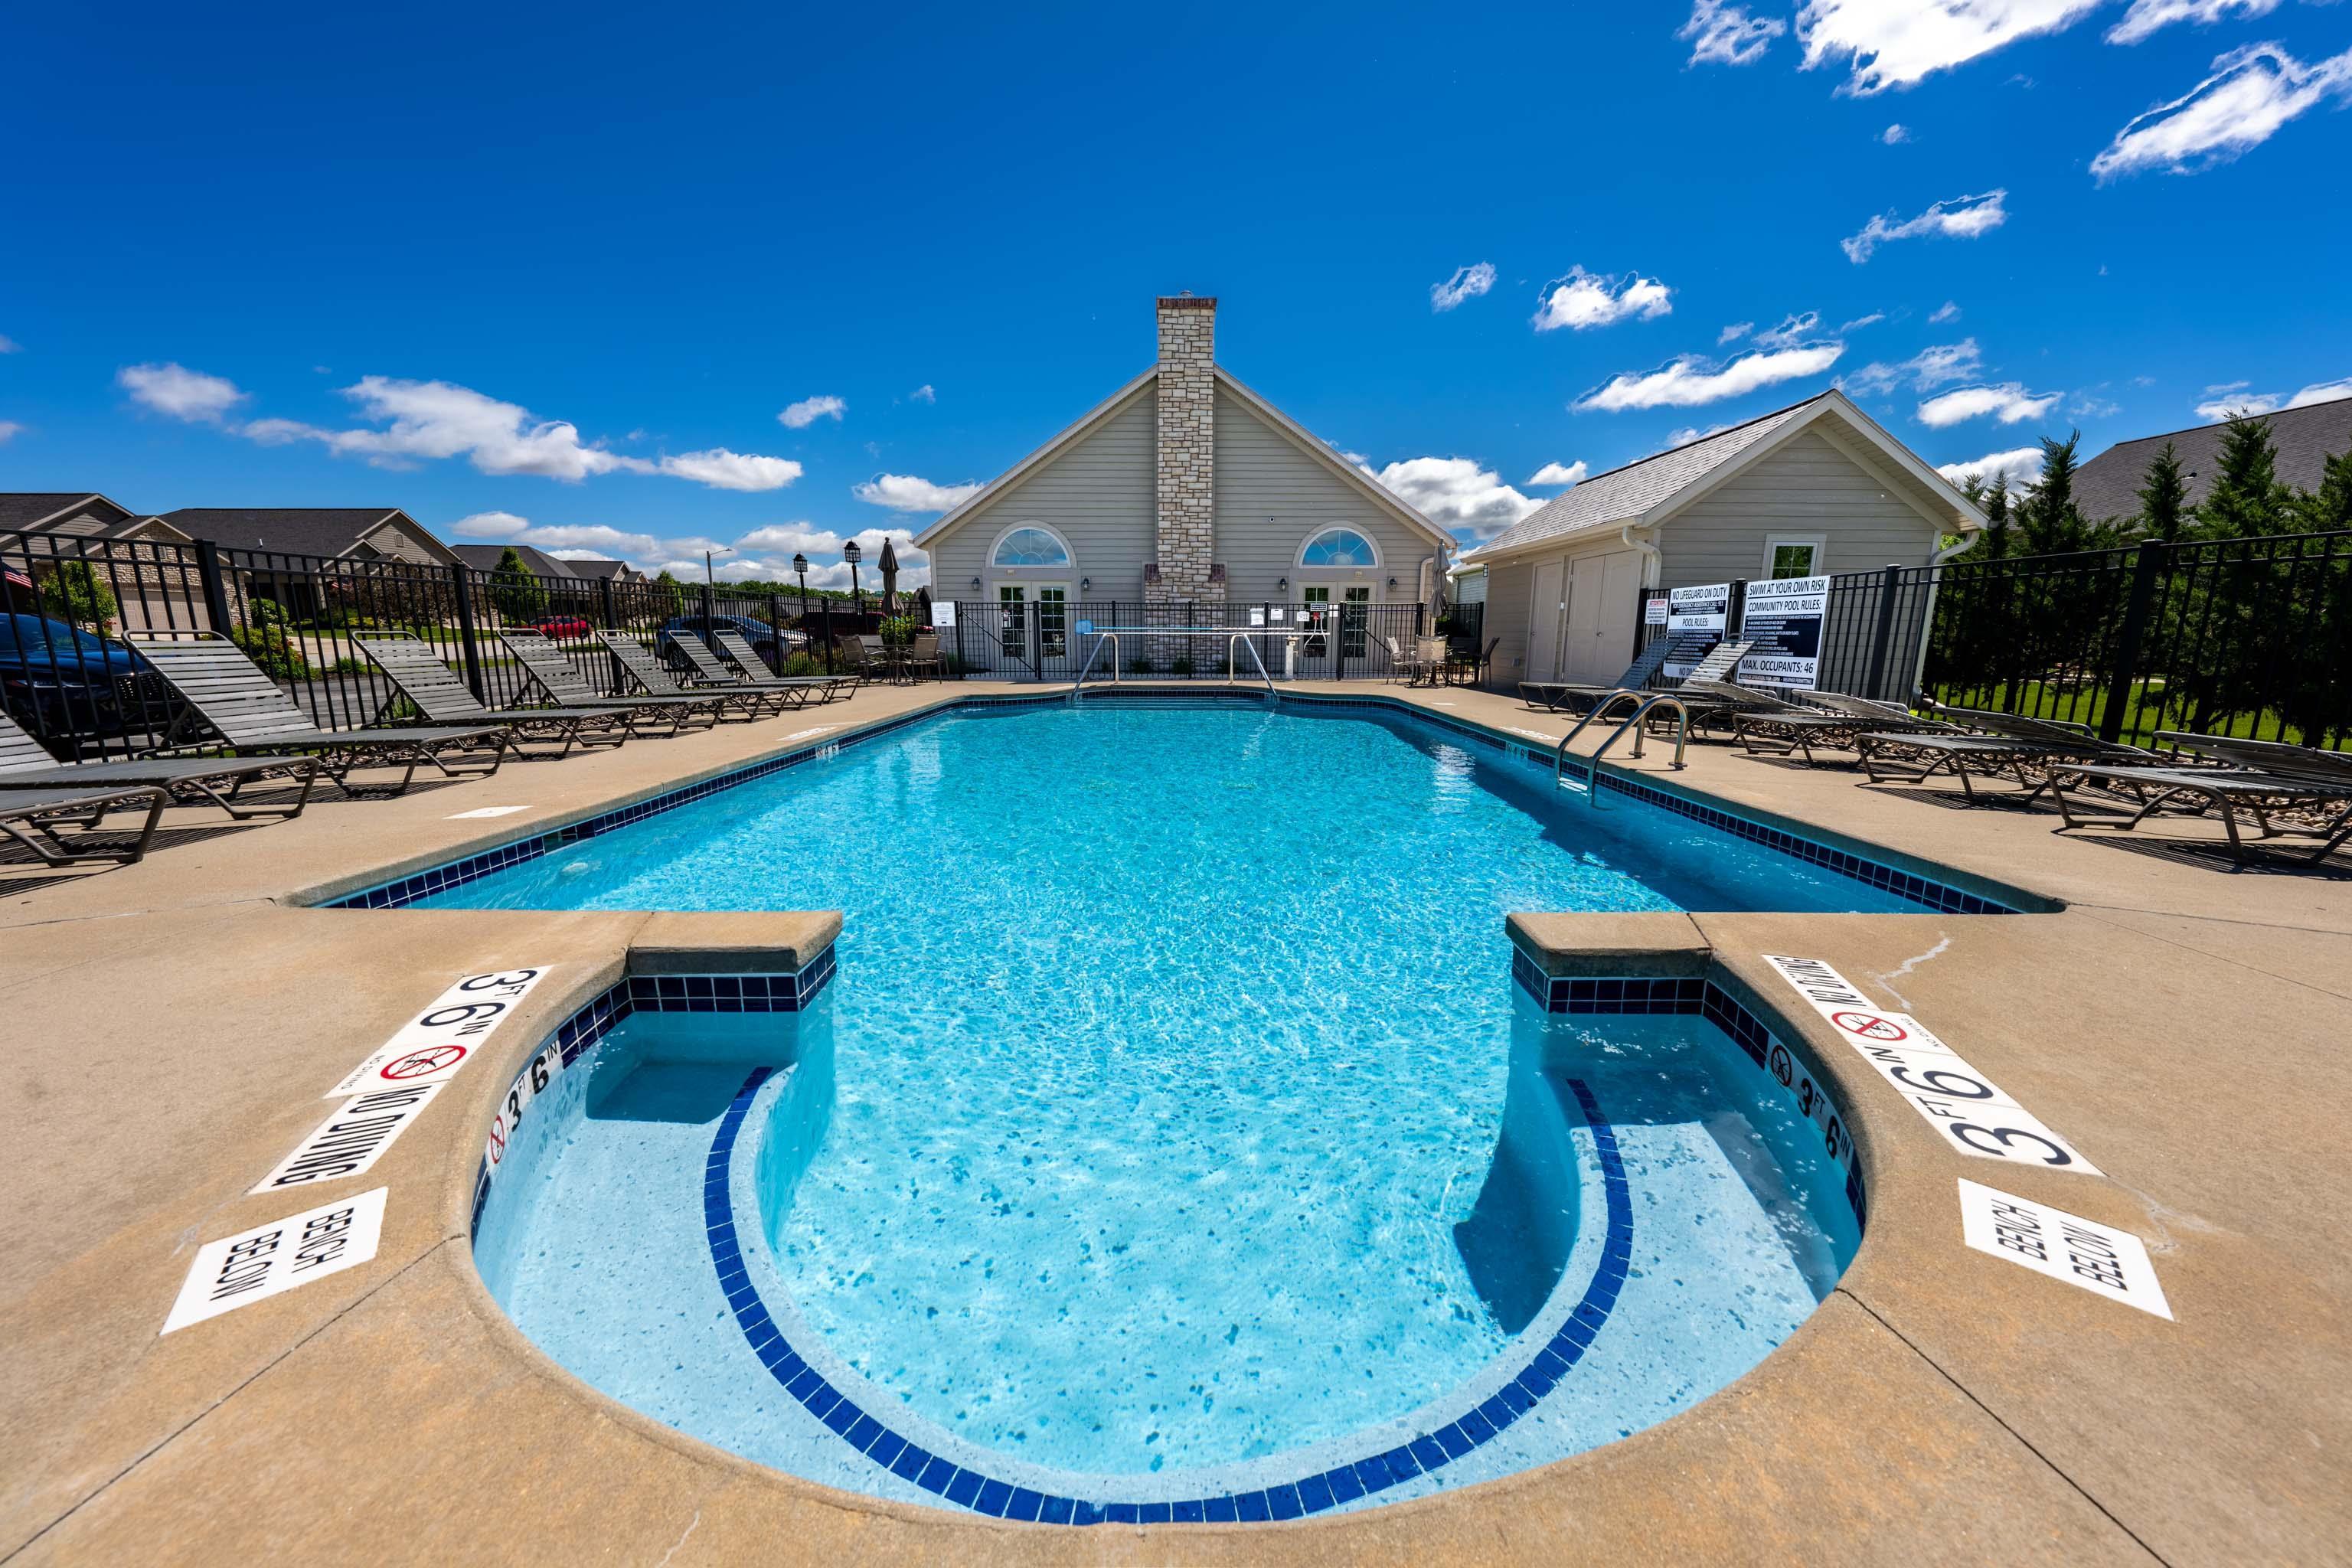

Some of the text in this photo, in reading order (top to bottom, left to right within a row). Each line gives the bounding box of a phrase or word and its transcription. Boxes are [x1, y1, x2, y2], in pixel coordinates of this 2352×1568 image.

[1673, 587, 1726, 600] NO LIFEGUARD ON DUTY
[1749, 580, 1825, 595] SWIM AT YOUR OWN RISK
[1749, 599, 1821, 612] COMMUNITY POOL RULES:
[1694, 618, 1709, 626] RULES:
[1742, 659, 1814, 673] MAX. OCCUPANTS: 46
[420, 969, 537, 1037] 3 FT 6 IN
[1773, 957, 1867, 1006] NO DIVING
[369, 1055, 386, 1064] NO
[508, 1041, 557, 1132] 3 FT 6 IN
[270, 1086, 433, 1187] NO DIVING
[1798, 1078, 1851, 1159] 3 FT 6 IN
[1864, 1046, 2072, 1165] 3 FT 6 IN
[291, 1207, 354, 1273] BENCH
[1990, 1199, 2049, 1262] BENCH
[2060, 1220, 2128, 1292] BELOW
[209, 1230, 282, 1301] BELOW
